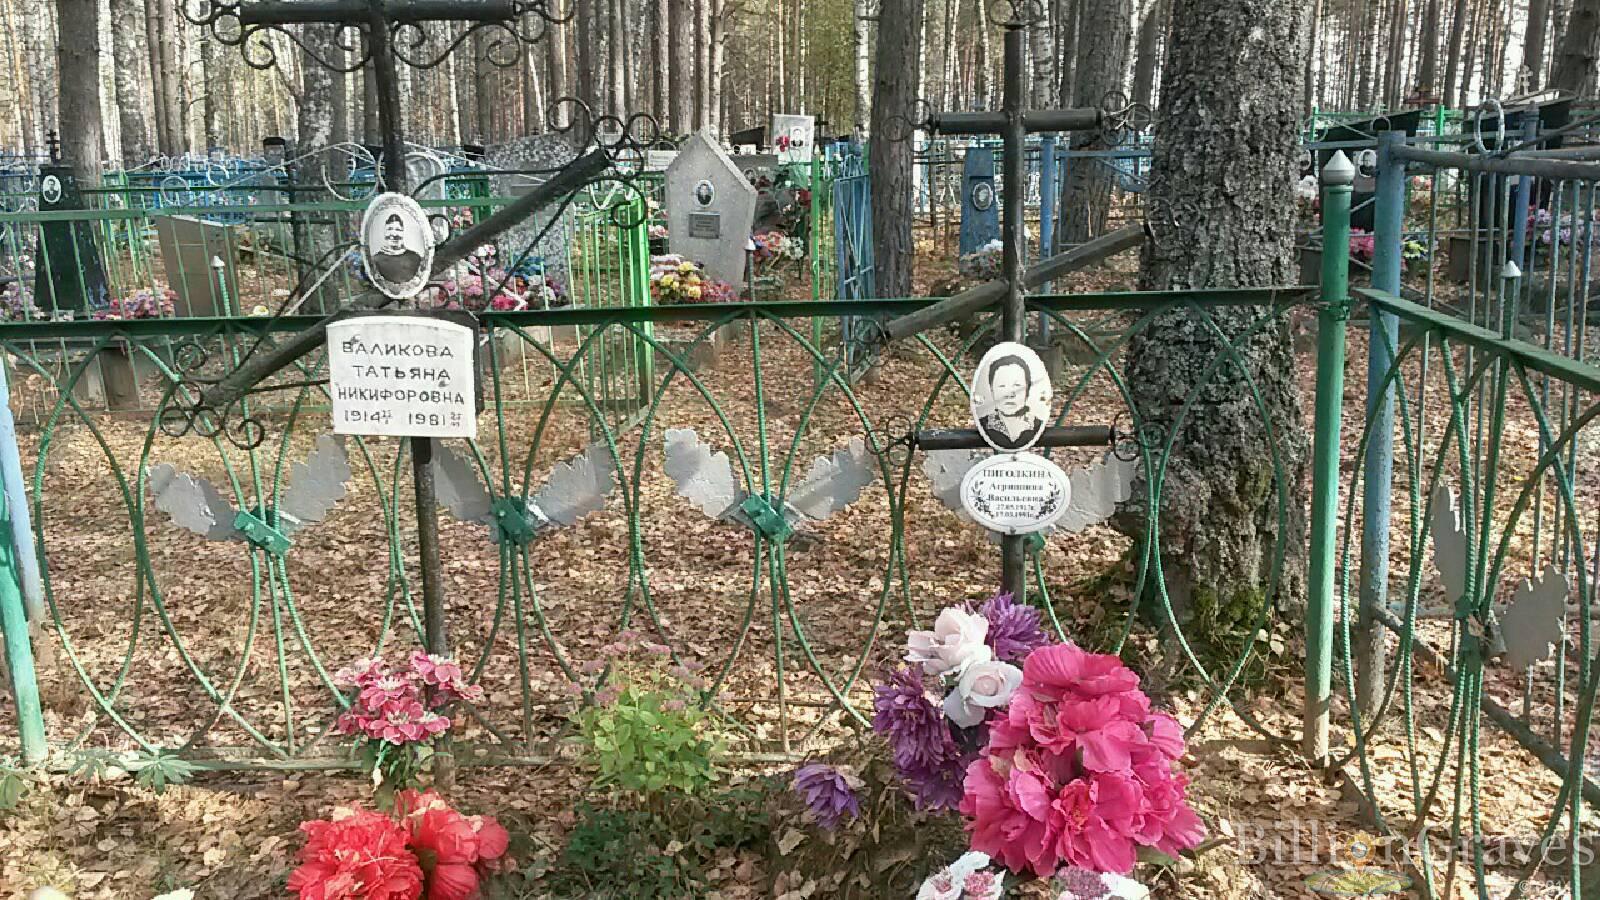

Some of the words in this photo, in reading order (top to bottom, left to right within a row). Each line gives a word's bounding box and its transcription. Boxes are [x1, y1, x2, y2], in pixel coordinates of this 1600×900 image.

[342, 341, 454, 358] ВАЛИКОВА
[352, 365, 451, 381] ТАТЬЯНА
[338, 386, 465, 405] НИКИФОРОВНА
[344, 410, 381, 423] 1914
[408, 413, 446, 426] 1981
